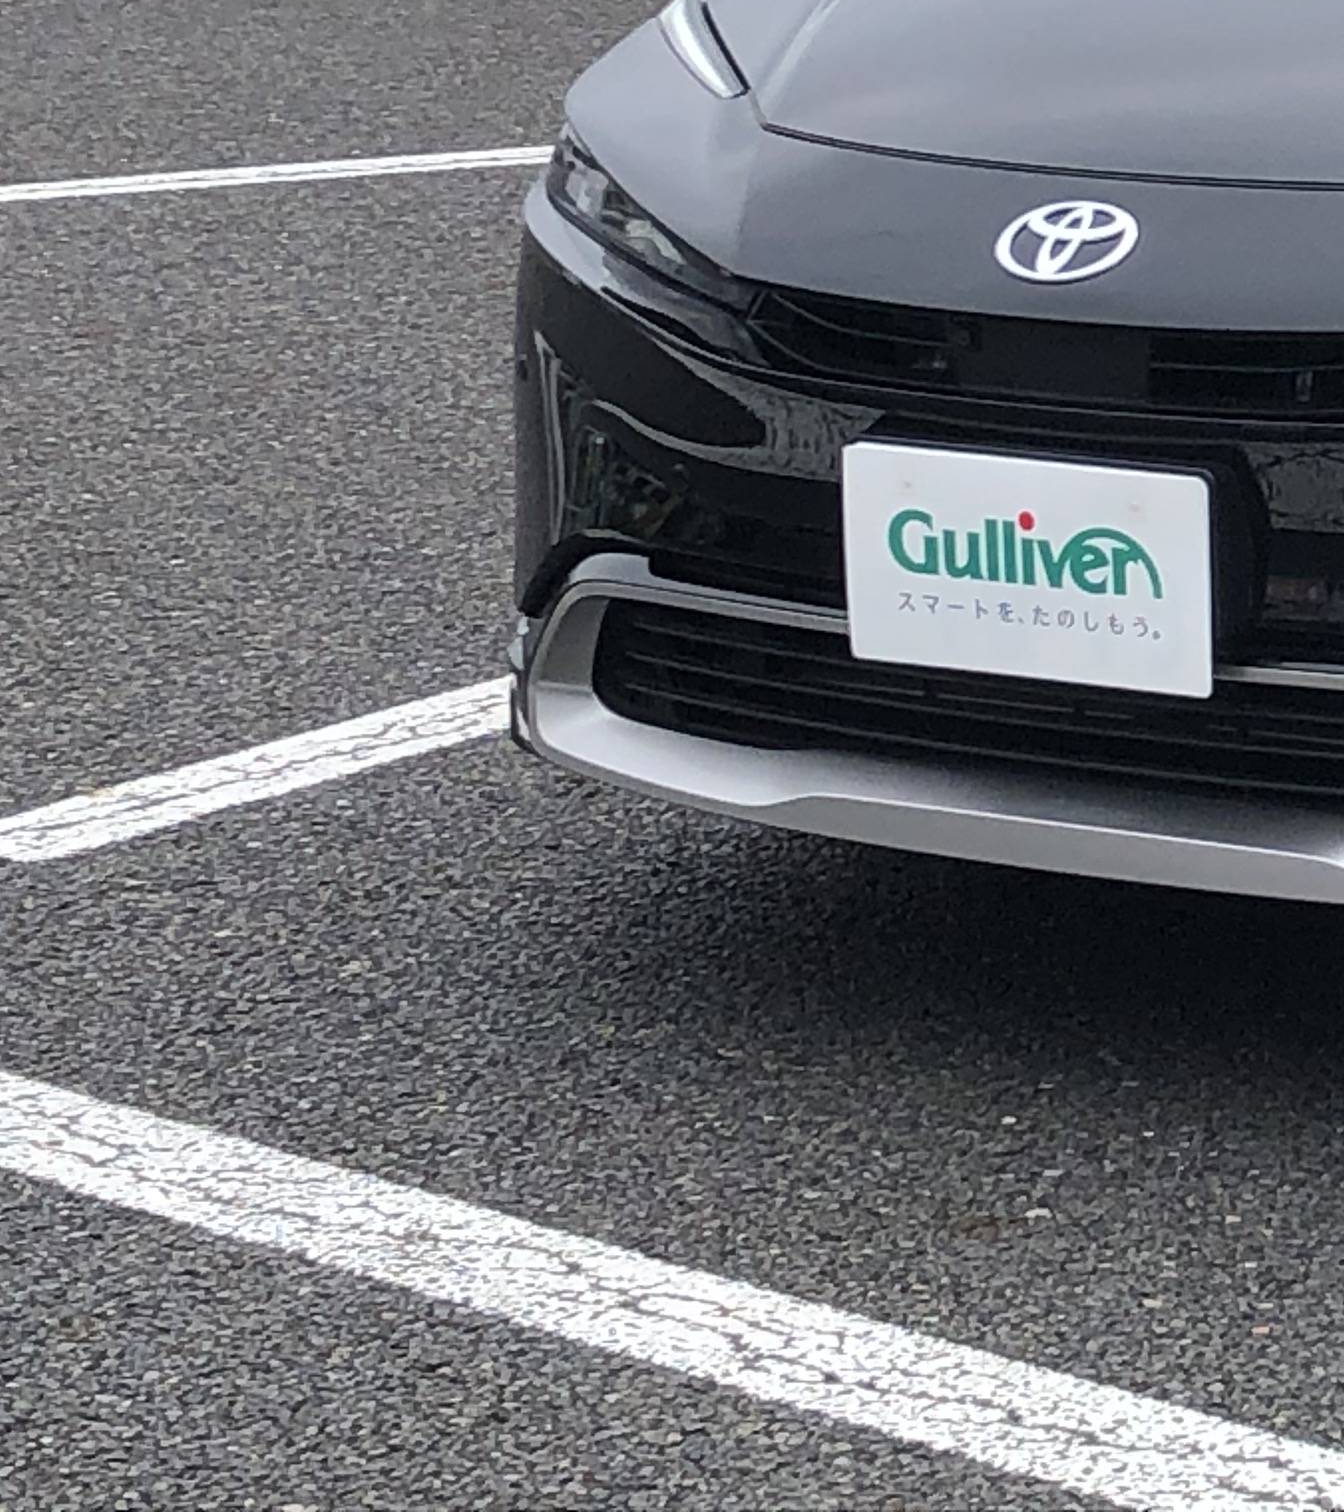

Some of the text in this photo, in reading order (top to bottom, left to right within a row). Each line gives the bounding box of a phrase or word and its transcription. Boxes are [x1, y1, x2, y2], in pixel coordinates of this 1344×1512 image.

[887, 507, 1164, 600] Gulliver
[898, 591, 1162, 641] スマートを、たのしもう。
